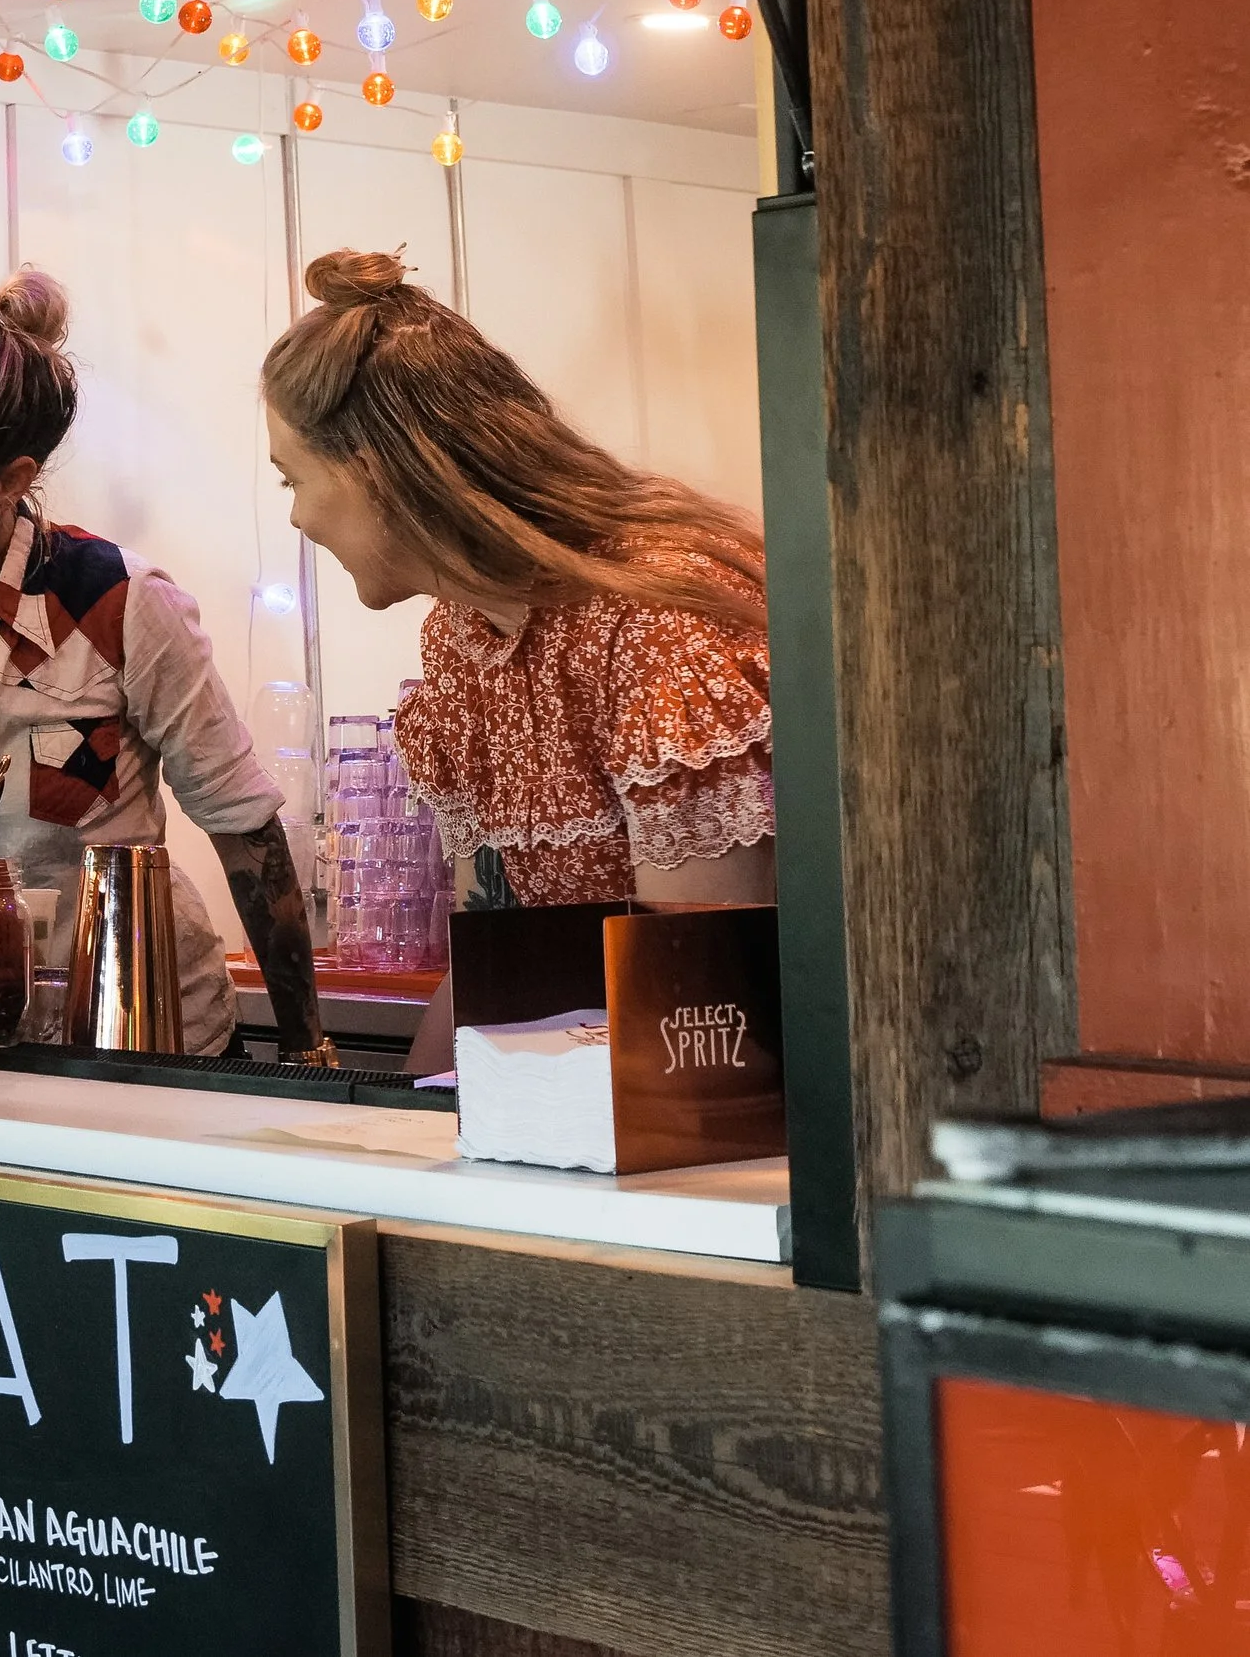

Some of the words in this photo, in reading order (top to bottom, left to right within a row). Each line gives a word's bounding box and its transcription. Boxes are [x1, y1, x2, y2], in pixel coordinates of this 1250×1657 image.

[669, 1003, 736, 1029] SELECT
[660, 1010, 747, 1074] SPRITZ
[46, 1506, 219, 1576] AGUACHILE
[103, 1572, 156, 1608] LIME
